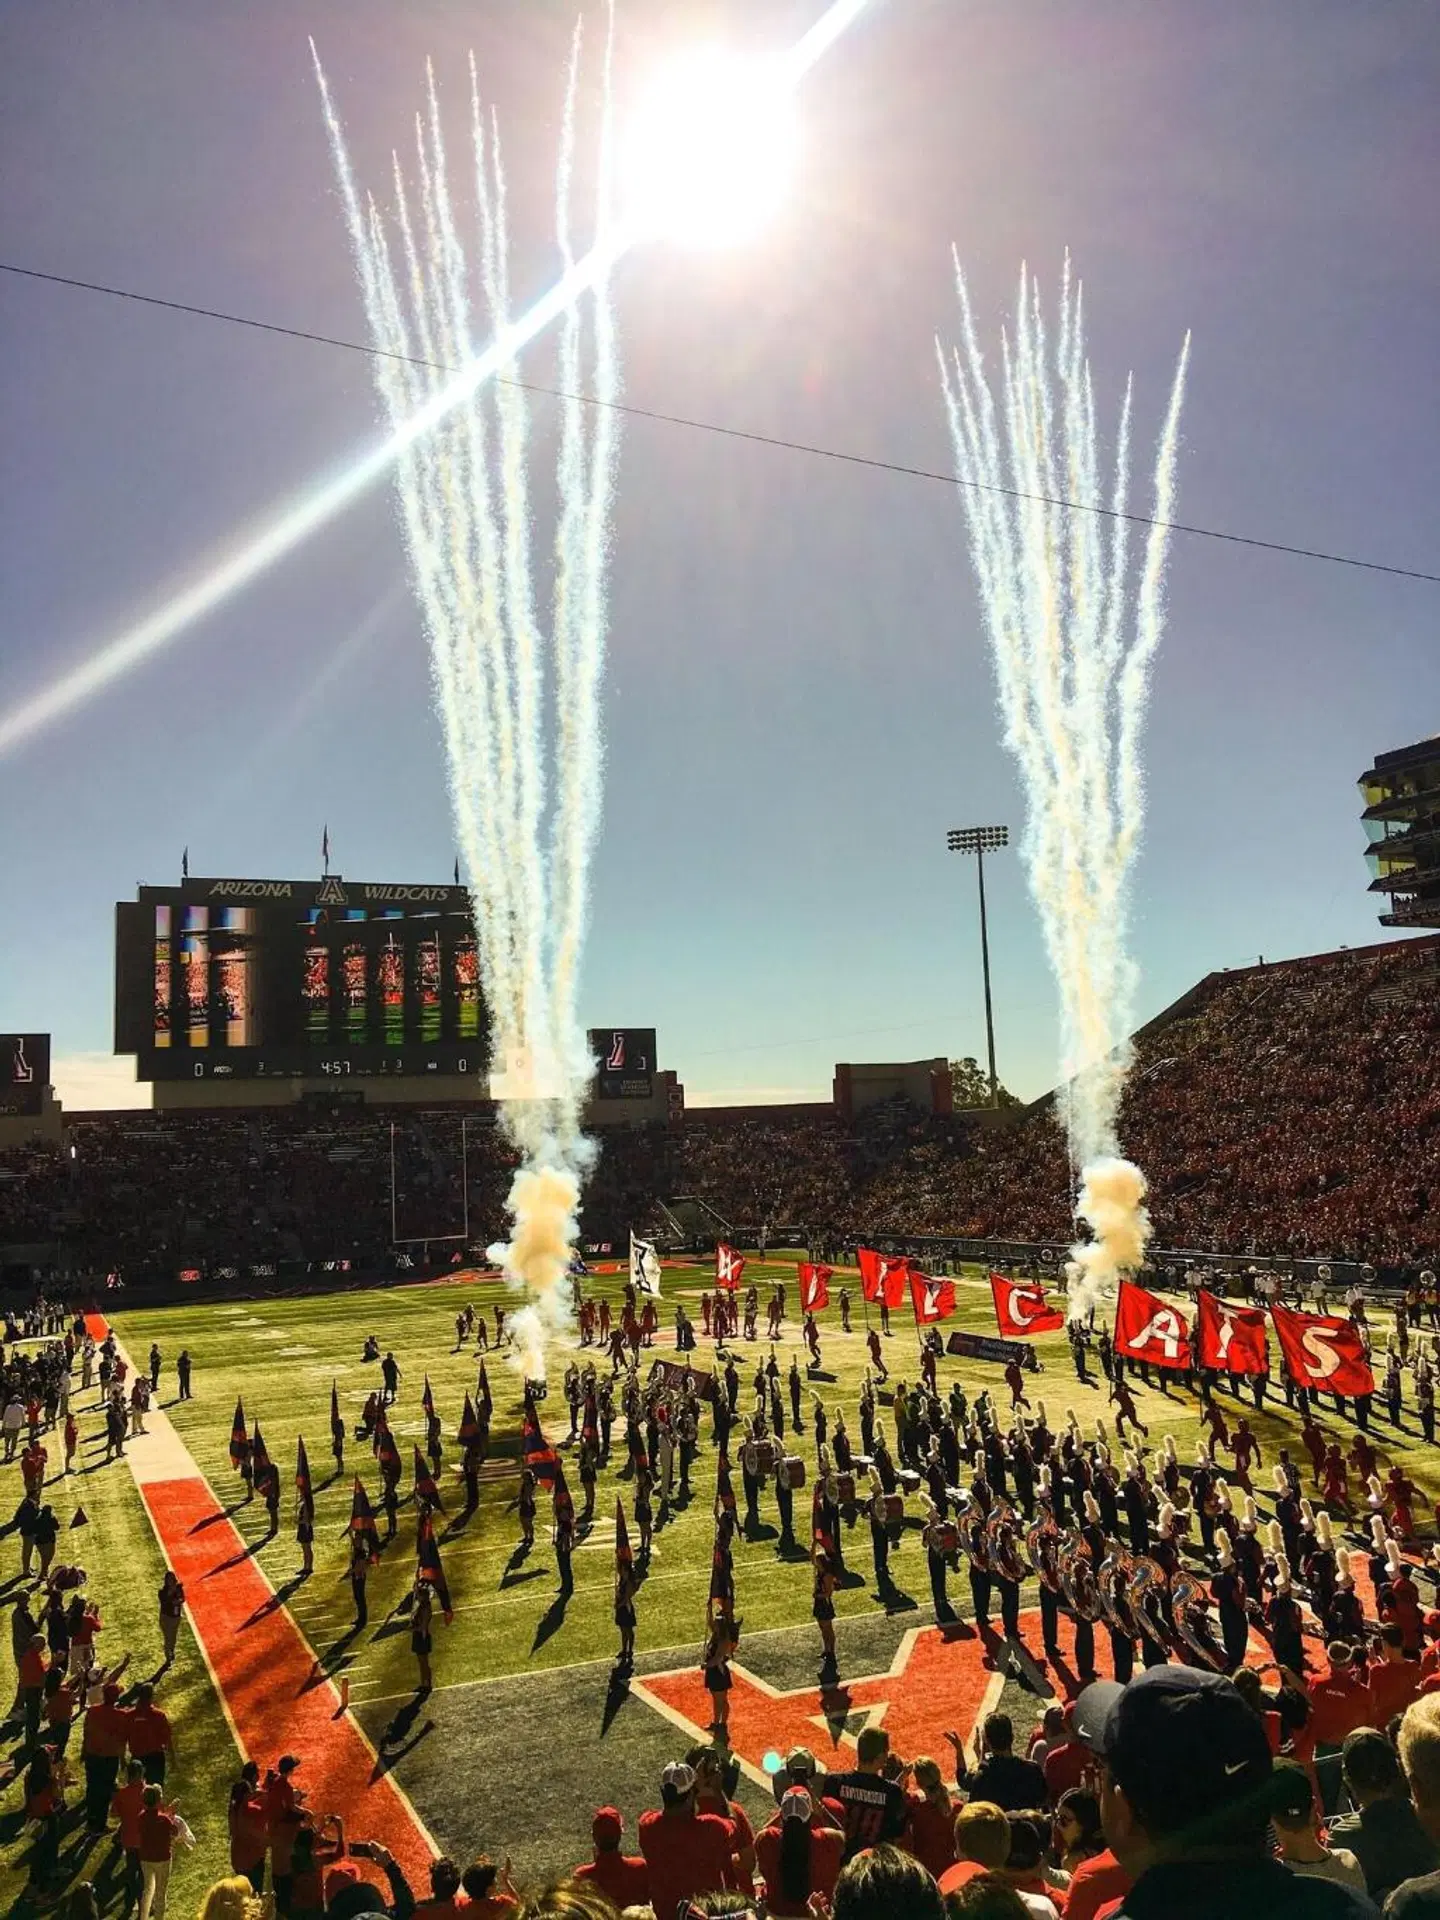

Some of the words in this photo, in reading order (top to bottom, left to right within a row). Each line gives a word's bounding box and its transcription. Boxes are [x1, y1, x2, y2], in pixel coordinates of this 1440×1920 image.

[208, 880, 293, 898] ARIZONA
[363, 885, 450, 902] WILDCATS
[320, 1060, 351, 1075] 4:57
[1008, 1287, 1037, 1327] C
[1128, 1309, 1180, 1359] A
[1301, 1326, 1341, 1379] S
